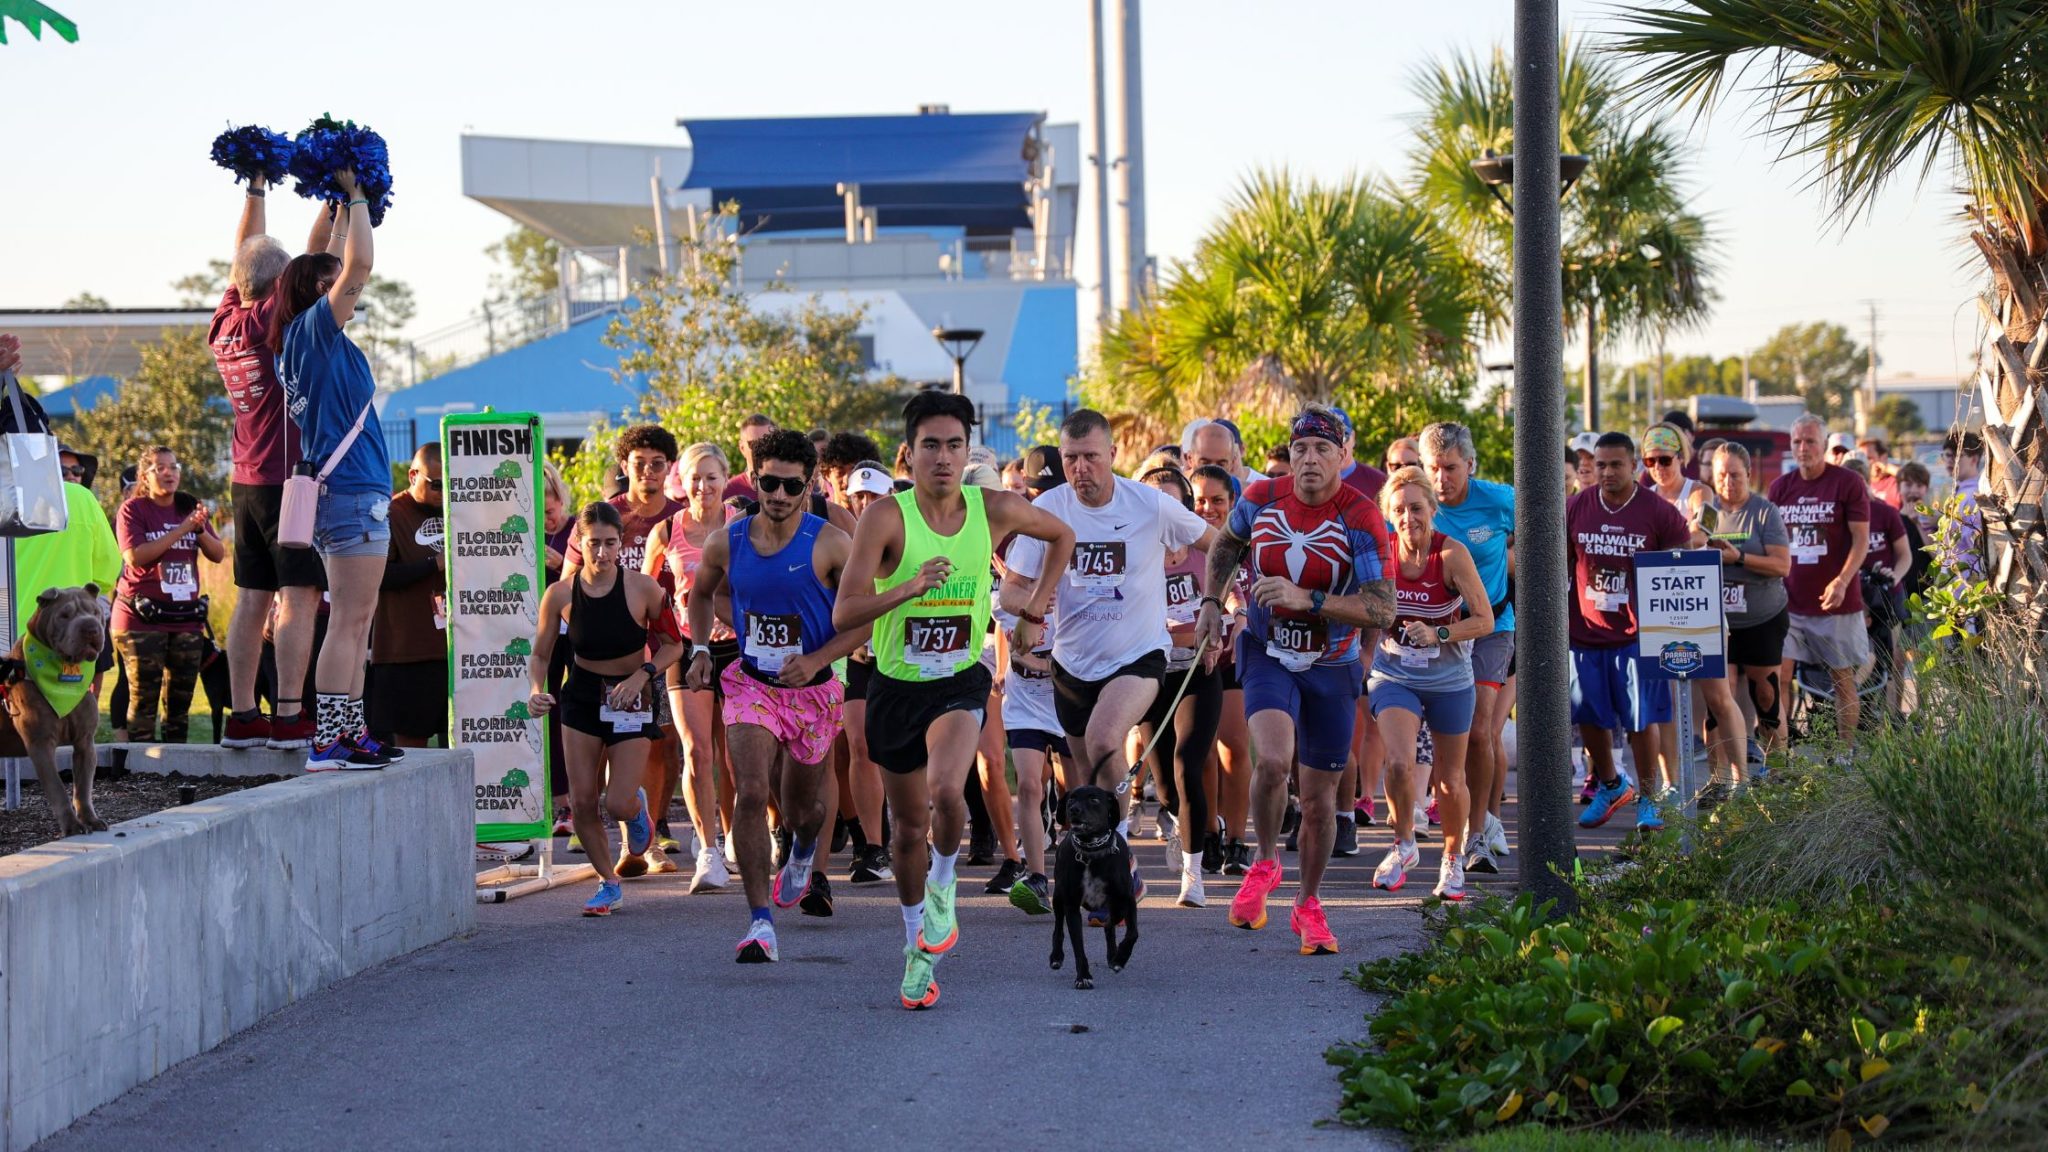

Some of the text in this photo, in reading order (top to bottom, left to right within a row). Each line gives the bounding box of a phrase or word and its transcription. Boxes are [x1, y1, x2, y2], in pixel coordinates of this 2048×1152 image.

[450, 429, 531, 456] FINISH
[450, 477, 516, 490] FLORIDA
[457, 531, 523, 544] FLORIDA
[1083, 551, 1114, 573] 745
[166, 567, 187, 583] 726
[1651, 575, 1706, 591] START
[459, 590, 524, 603] FLORIDA
[1396, 590, 1430, 602] OKYO
[1650, 597, 1709, 612] FINISH
[757, 623, 789, 645] 633
[920, 627, 957, 650] 737
[1280, 627, 1312, 650] 801
[461, 653, 527, 667] FLORIDA
[461, 717, 527, 731] FLORIDA
[475, 784, 523, 798] ORIDA
